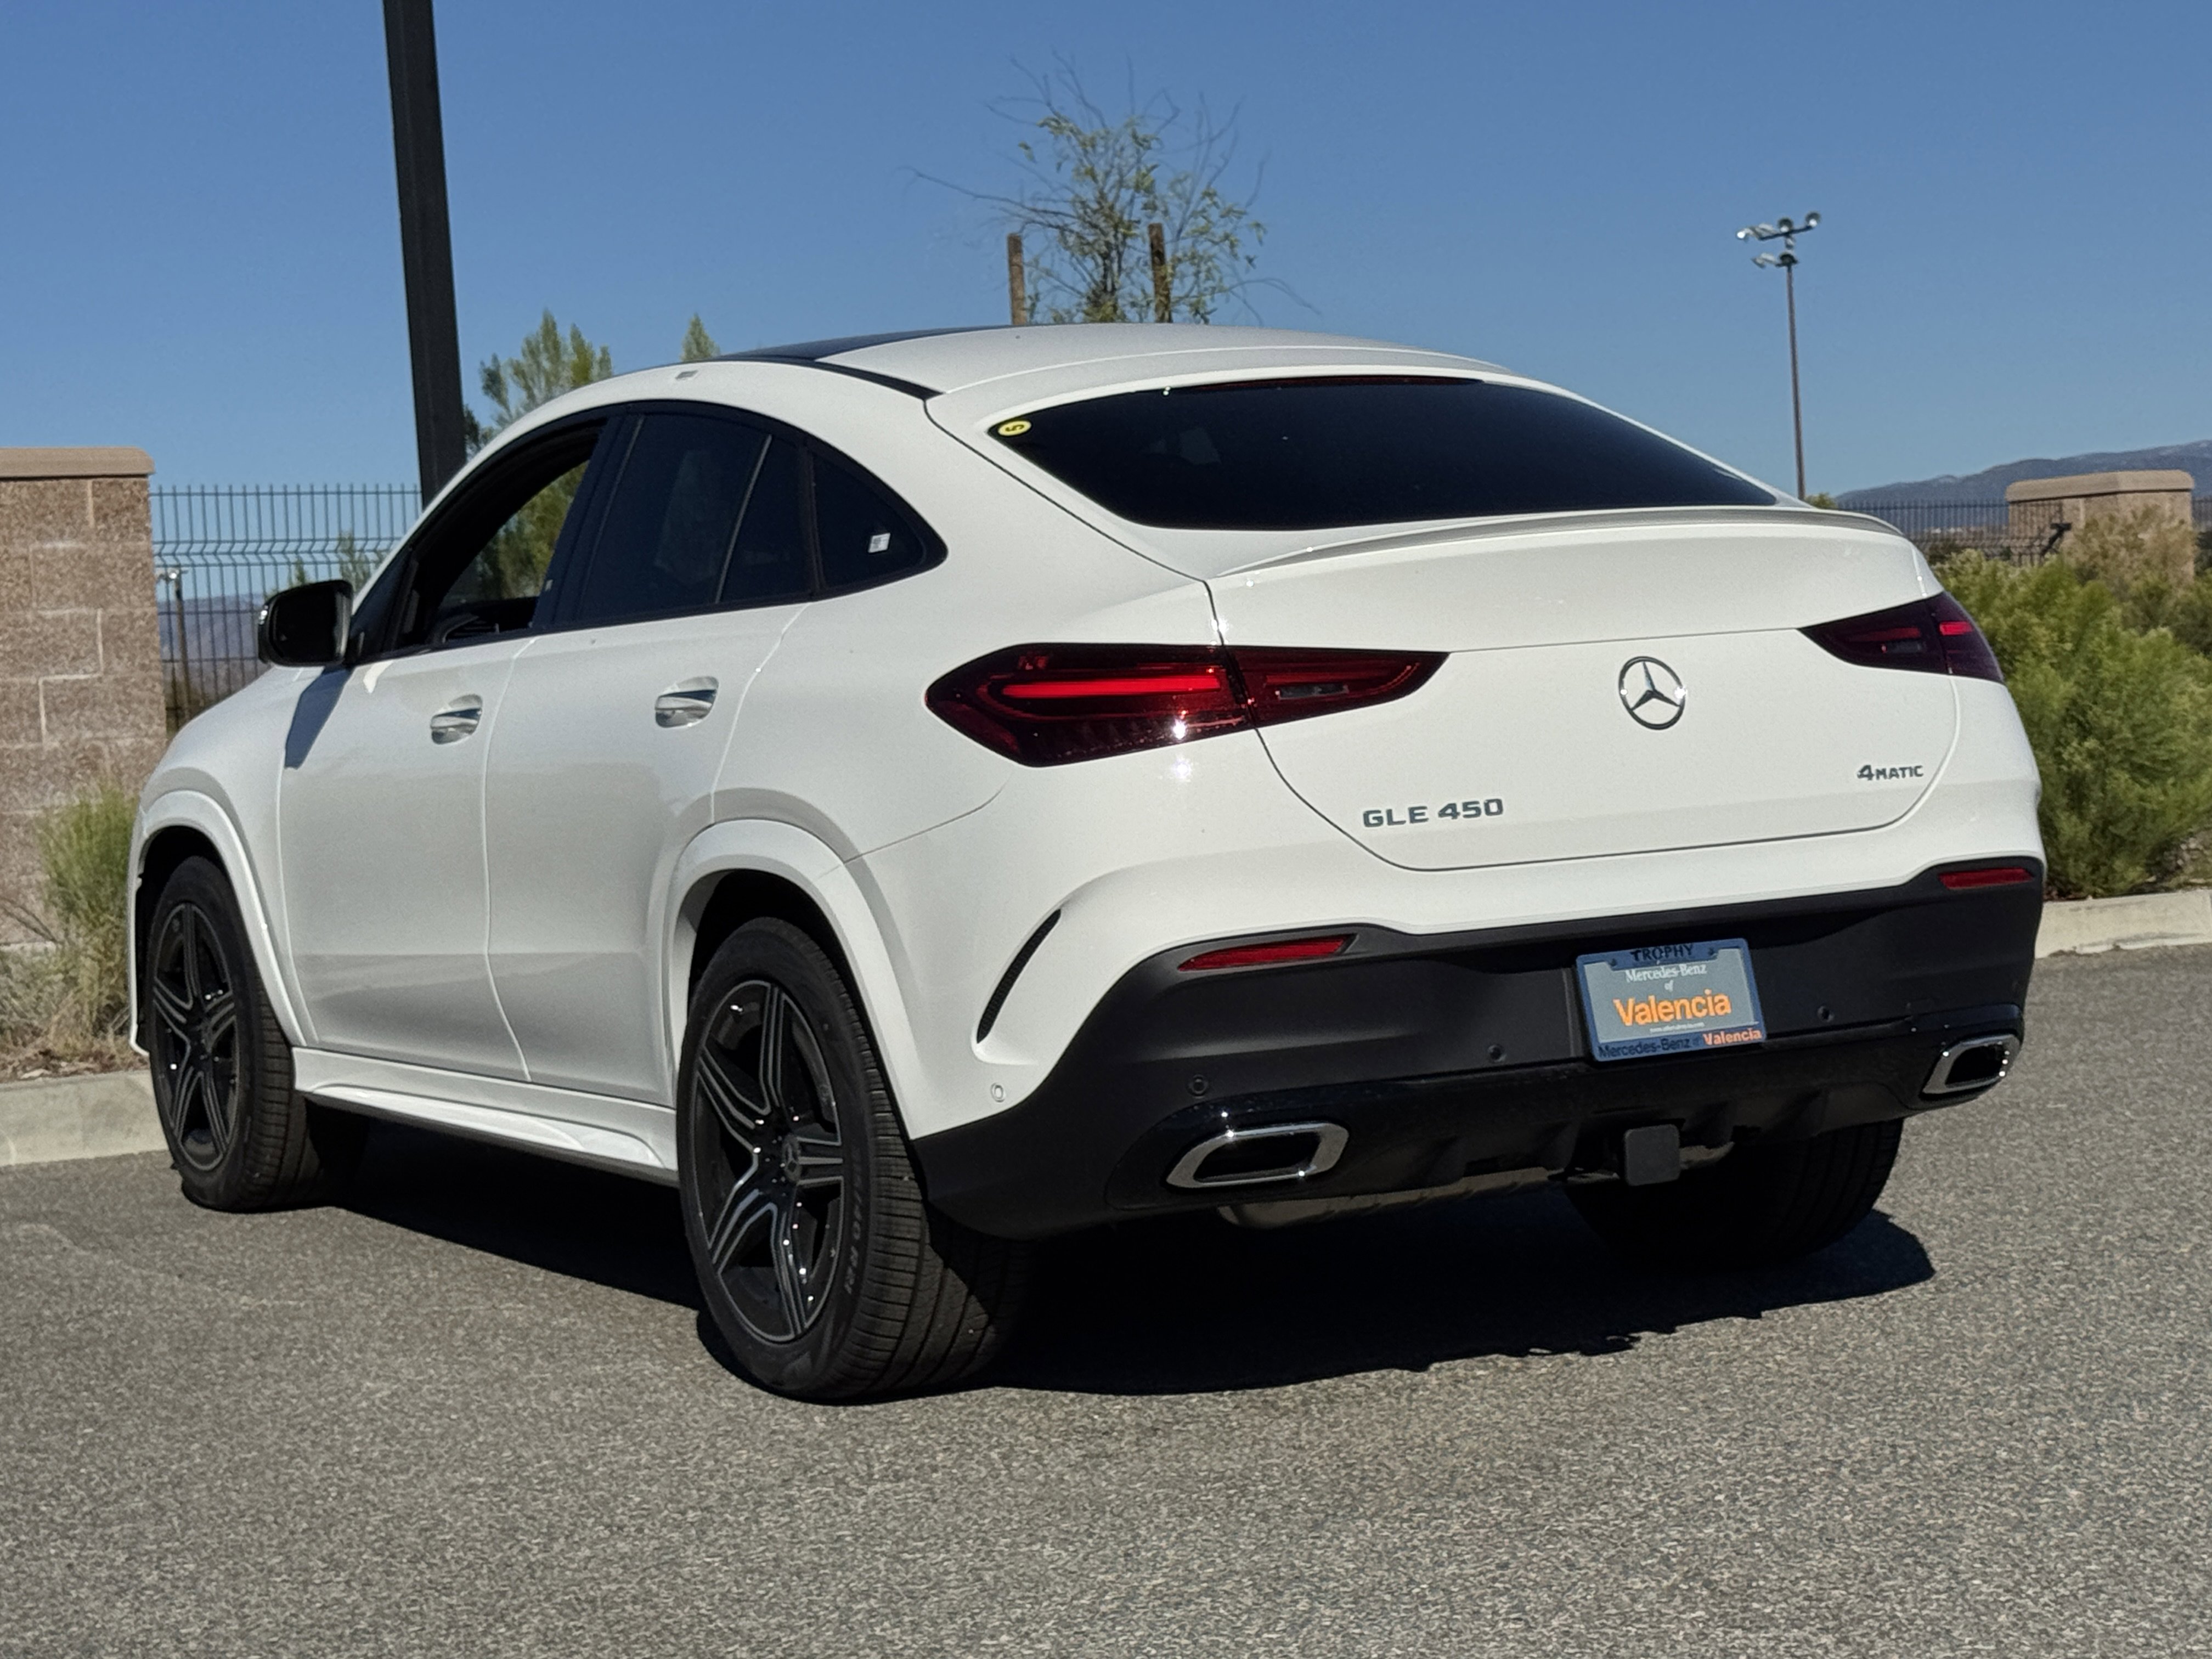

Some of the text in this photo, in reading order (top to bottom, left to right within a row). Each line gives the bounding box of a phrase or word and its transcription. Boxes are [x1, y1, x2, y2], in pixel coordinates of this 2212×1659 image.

[1857, 764, 1925, 781] 4MATIC
[1362, 798, 1504, 828] GLE 450
[1630, 944, 1694, 962] TROPHY
[1625, 963, 1707, 983] Mercedes-Benz
[1612, 988, 1732, 1027] Valencia
[1598, 1037, 1691, 1058] Mercedes-Benz
[1703, 1027, 1762, 1046] Valencia
